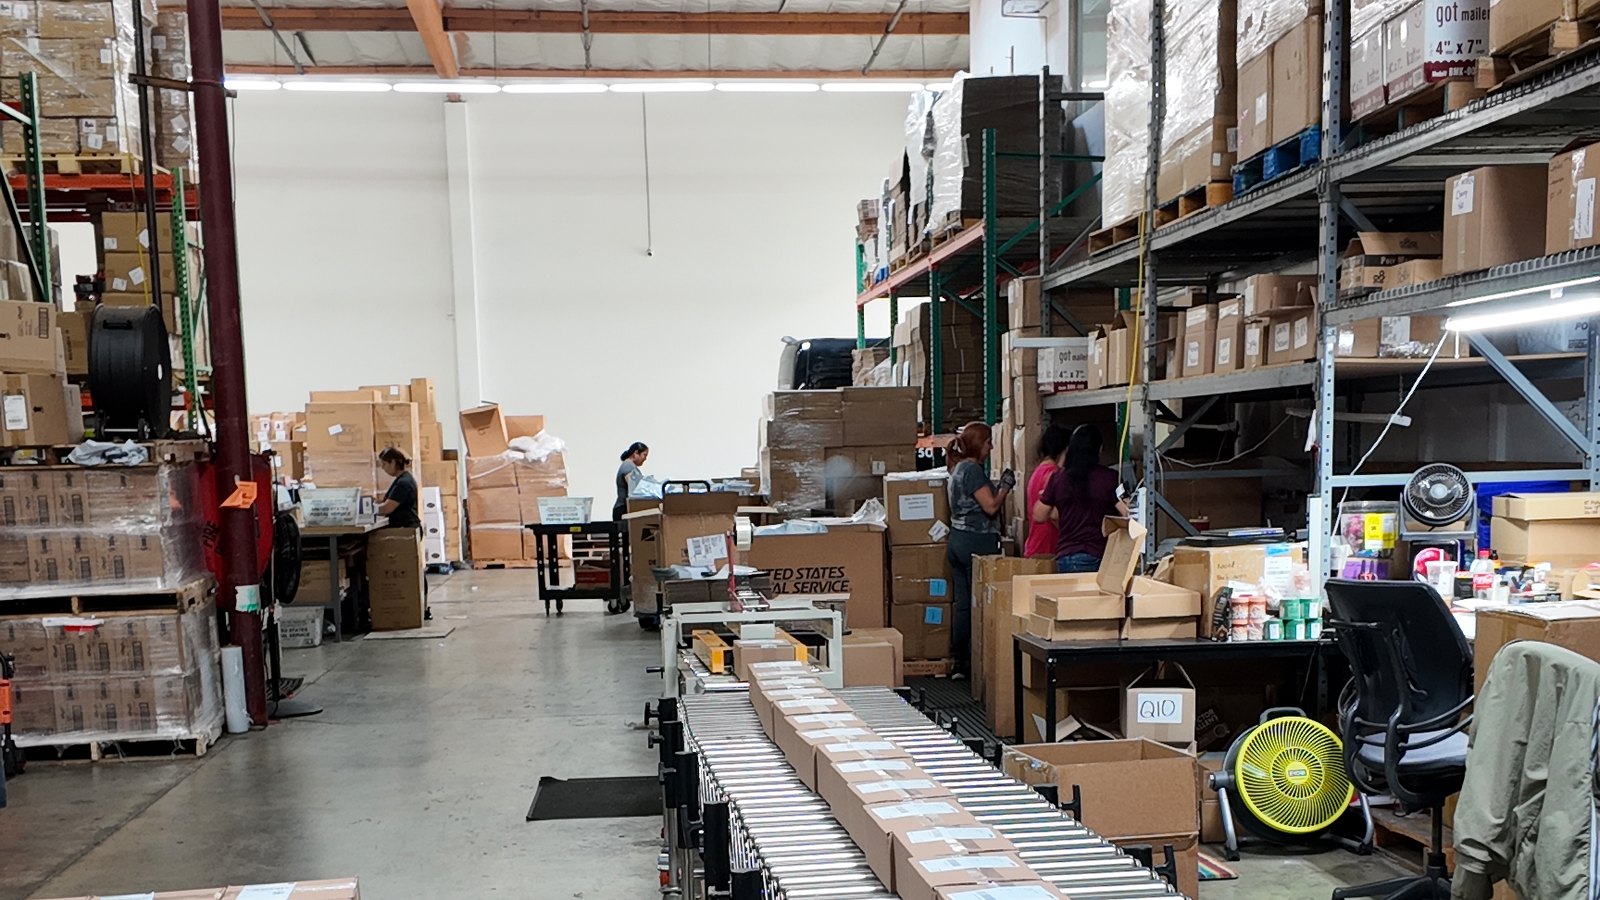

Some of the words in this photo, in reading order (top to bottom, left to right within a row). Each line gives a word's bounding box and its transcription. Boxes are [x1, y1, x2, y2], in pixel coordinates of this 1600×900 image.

[1436, 2, 1458, 27] got
[1436, 41, 1450, 54] 4"
[1456, 43, 1463, 54] x
[1468, 39, 1482, 53] 7"
[795, 566, 845, 580] STATES
[791, 580, 850, 594] SERVICE
